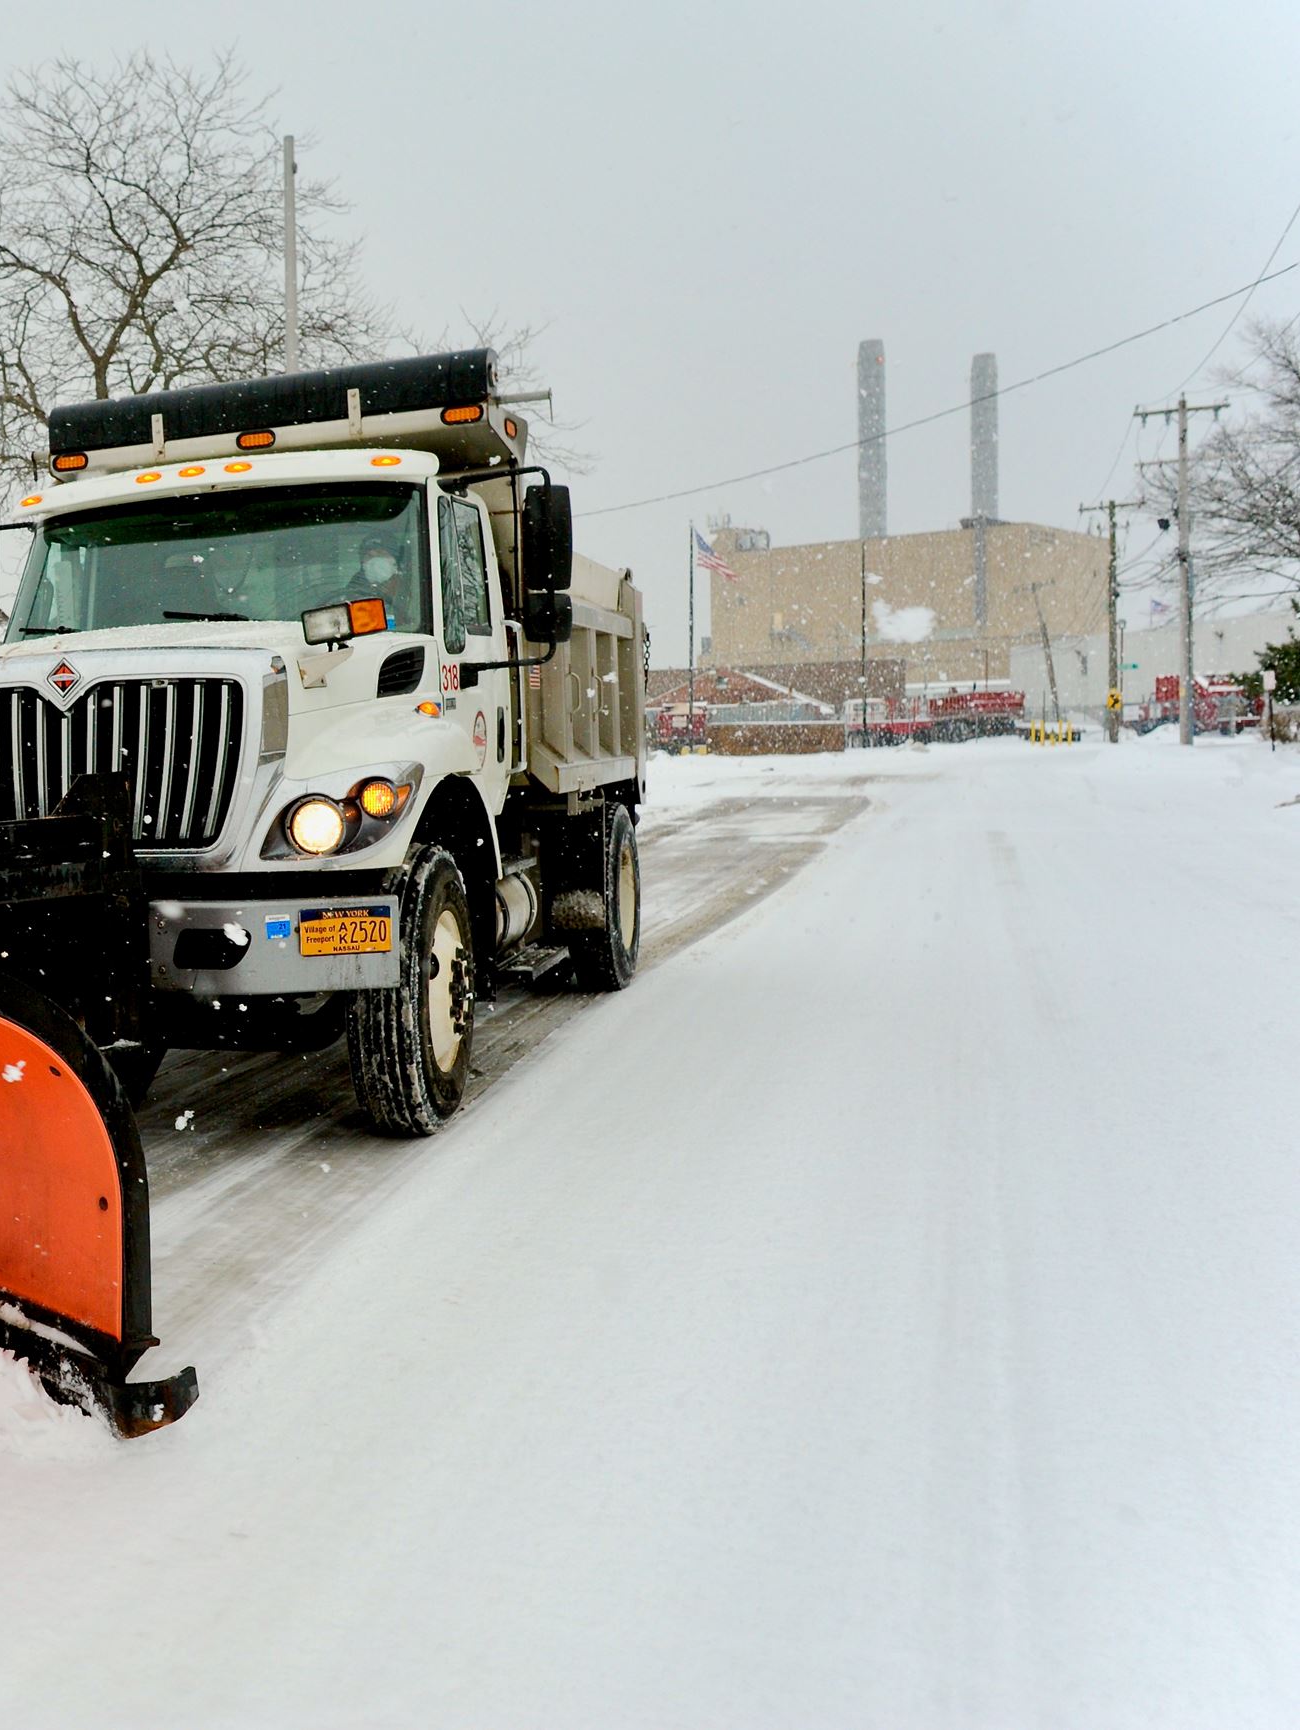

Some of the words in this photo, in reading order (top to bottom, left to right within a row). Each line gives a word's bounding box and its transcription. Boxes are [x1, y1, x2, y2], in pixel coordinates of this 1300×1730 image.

[441, 664, 459, 691] 318
[346, 910, 369, 918] YORK
[304, 926, 327, 934] Village
[328, 925, 336, 933] of
[306, 936, 334, 944] Freeport
